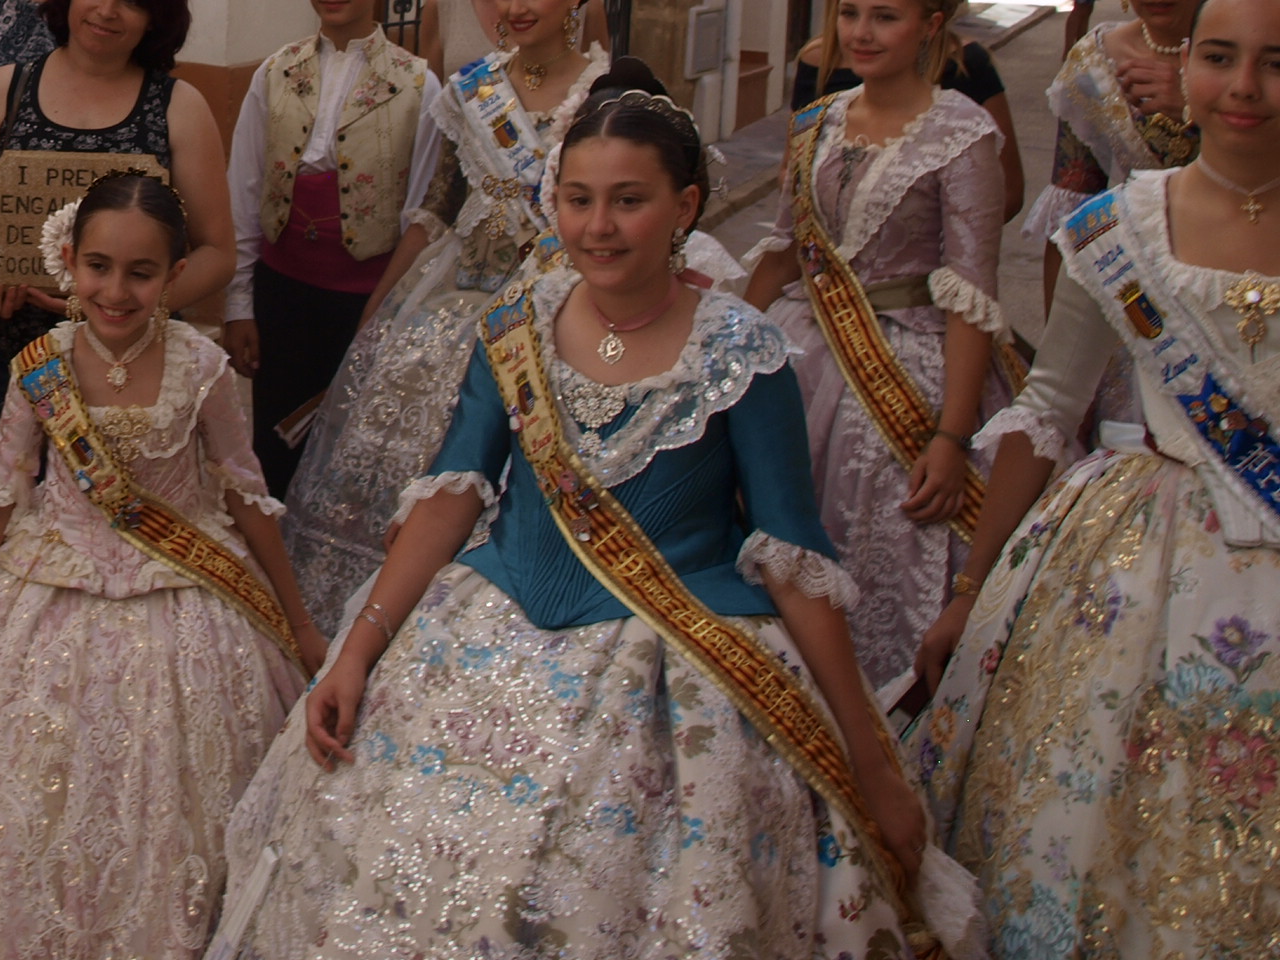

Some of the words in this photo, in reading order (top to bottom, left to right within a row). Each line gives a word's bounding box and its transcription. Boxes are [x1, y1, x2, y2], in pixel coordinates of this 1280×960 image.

[18, 165, 28, 186] I
[0, 194, 65, 215] ENGA
[6, 225, 34, 245] DE
[611, 549, 673, 609] Dama
[673, 609, 747, 669] d'Honor
